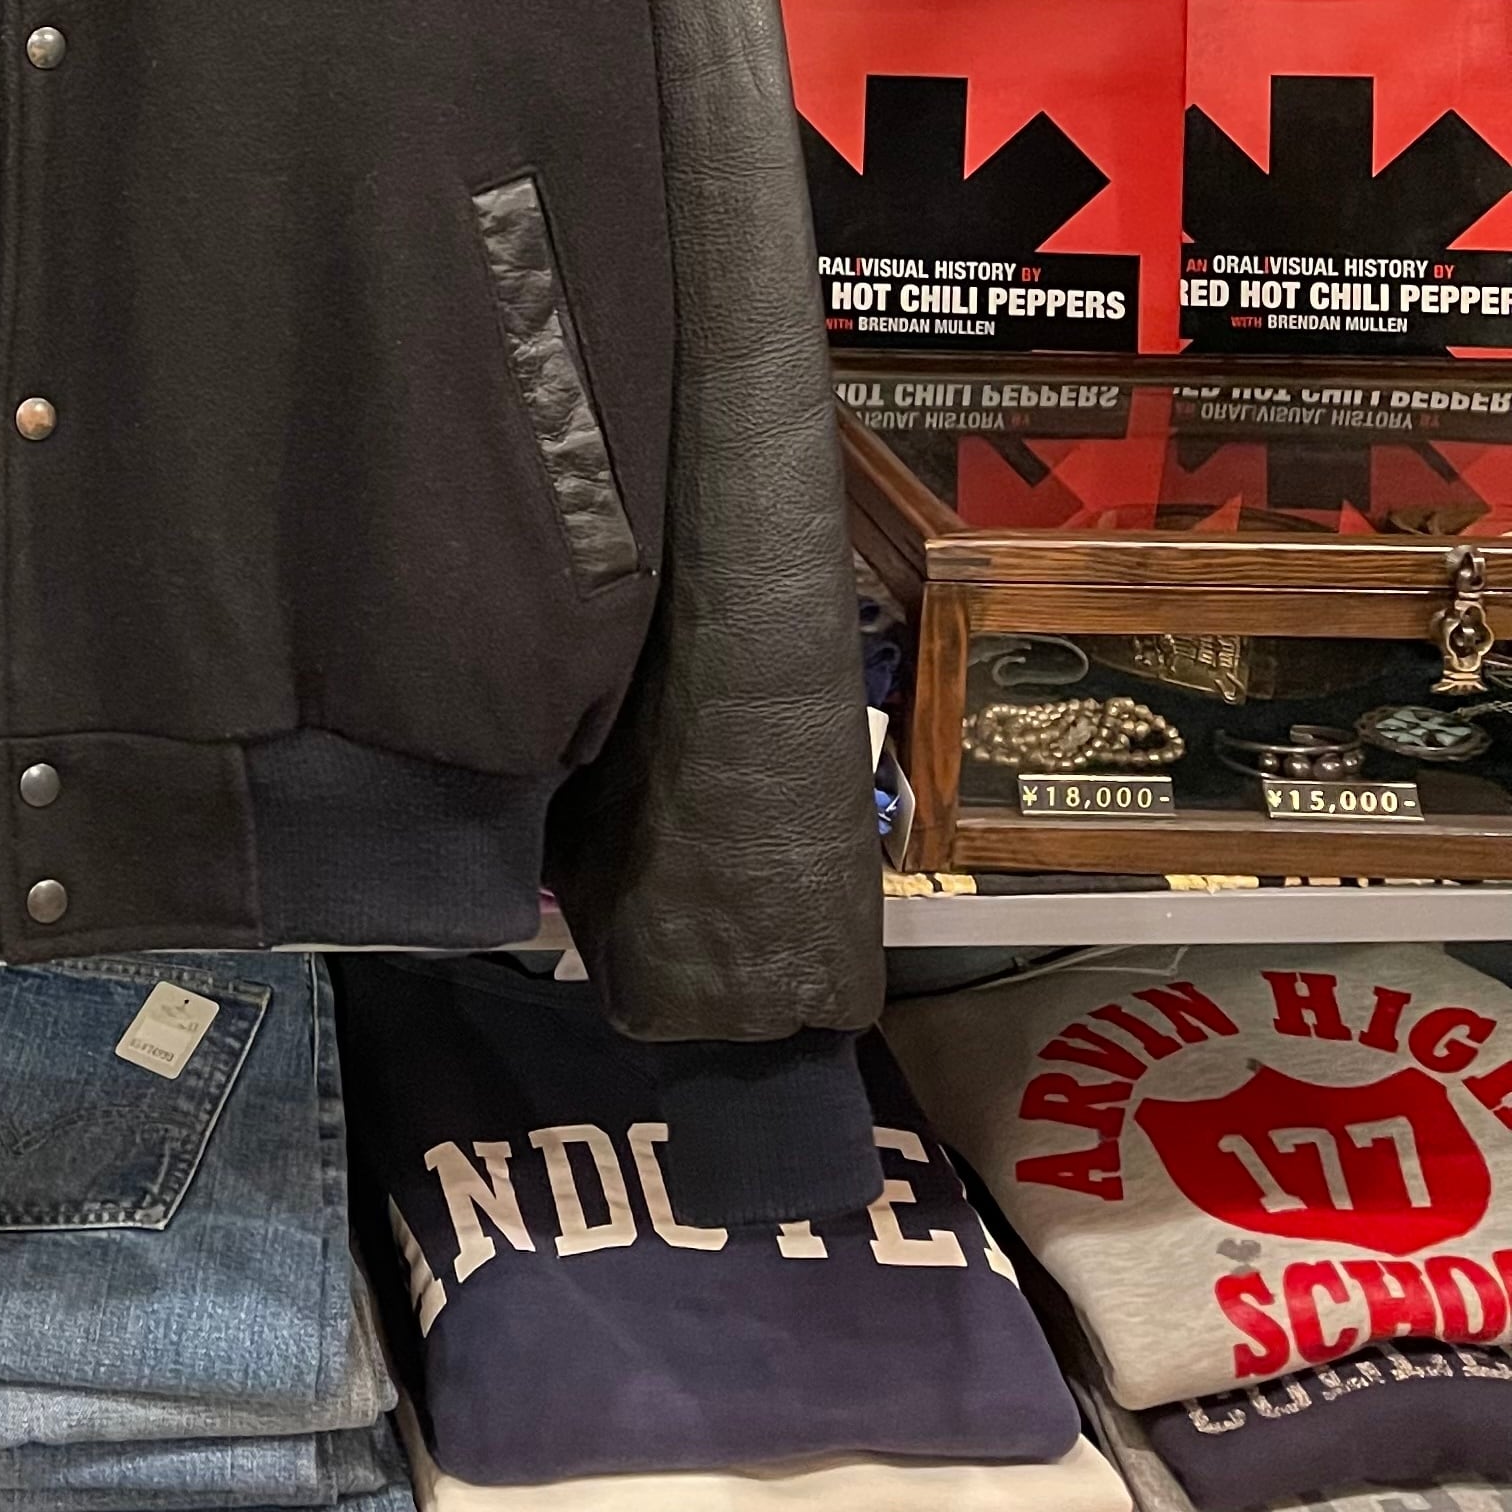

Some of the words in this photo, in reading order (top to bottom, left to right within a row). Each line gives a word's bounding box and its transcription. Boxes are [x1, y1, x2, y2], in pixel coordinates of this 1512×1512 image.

[935, 260, 1017, 282] HISTORY
[1021, 267, 1042, 282] BY
[1186, 258, 1208, 273] AN
[1344, 258, 1429, 279] HISTORY
[1434, 264, 1455, 279] BY
[831, 281, 892, 312] HOT
[899, 283, 978, 315] CHILI
[987, 288, 1126, 319] PEPPERS
[1240, 280, 1302, 310] HOT
[1309, 282, 1390, 312] CHILI
[858, 316, 930, 334] BRENDAN
[934, 318, 996, 336] MULLEN
[1230, 316, 1262, 329] WITH
[1267, 315, 1341, 331] BRENDAN
[1345, 316, 1408, 334] MULLEN
[1015, 981, 1239, 1201] ARVIN
[1218, 1114, 1432, 1215] 177
[1214, 1249, 1512, 1379] SCHO
